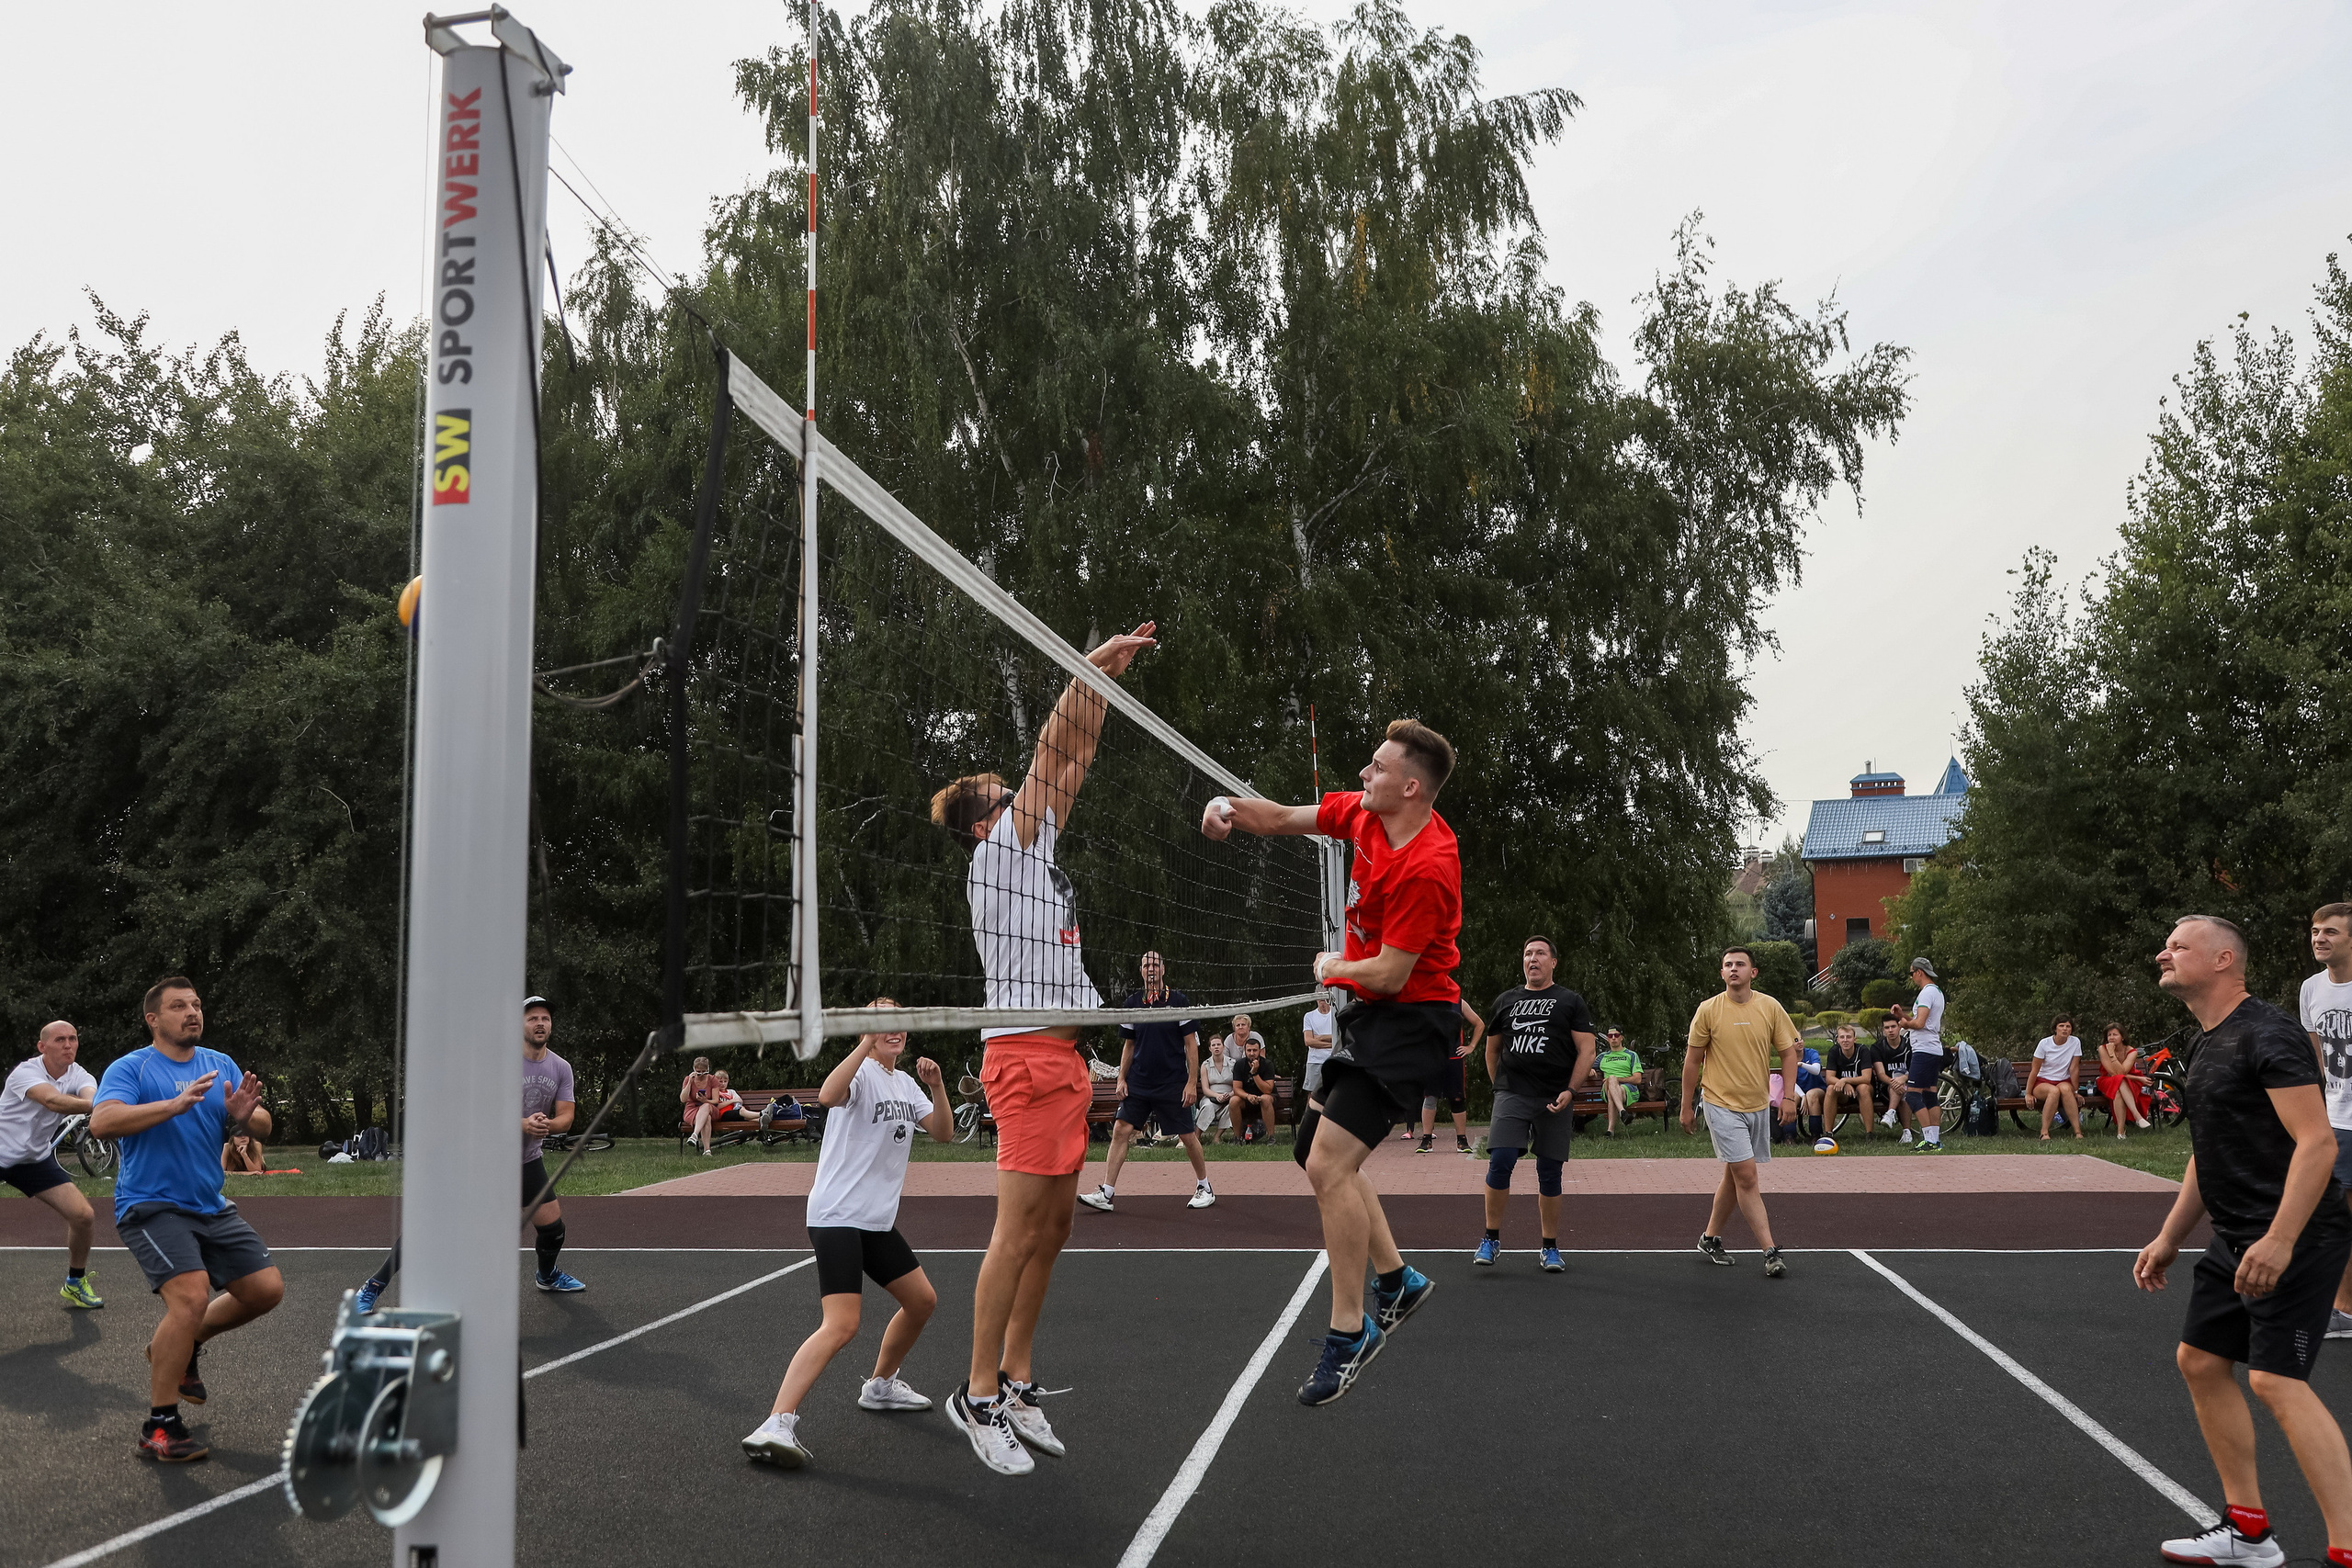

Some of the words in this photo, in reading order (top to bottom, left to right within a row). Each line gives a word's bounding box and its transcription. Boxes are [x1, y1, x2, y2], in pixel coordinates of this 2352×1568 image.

[434, 414, 471, 493] SW
[1510, 999, 1556, 1017] NIKE
[1510, 1035, 1549, 1054] NIKE
